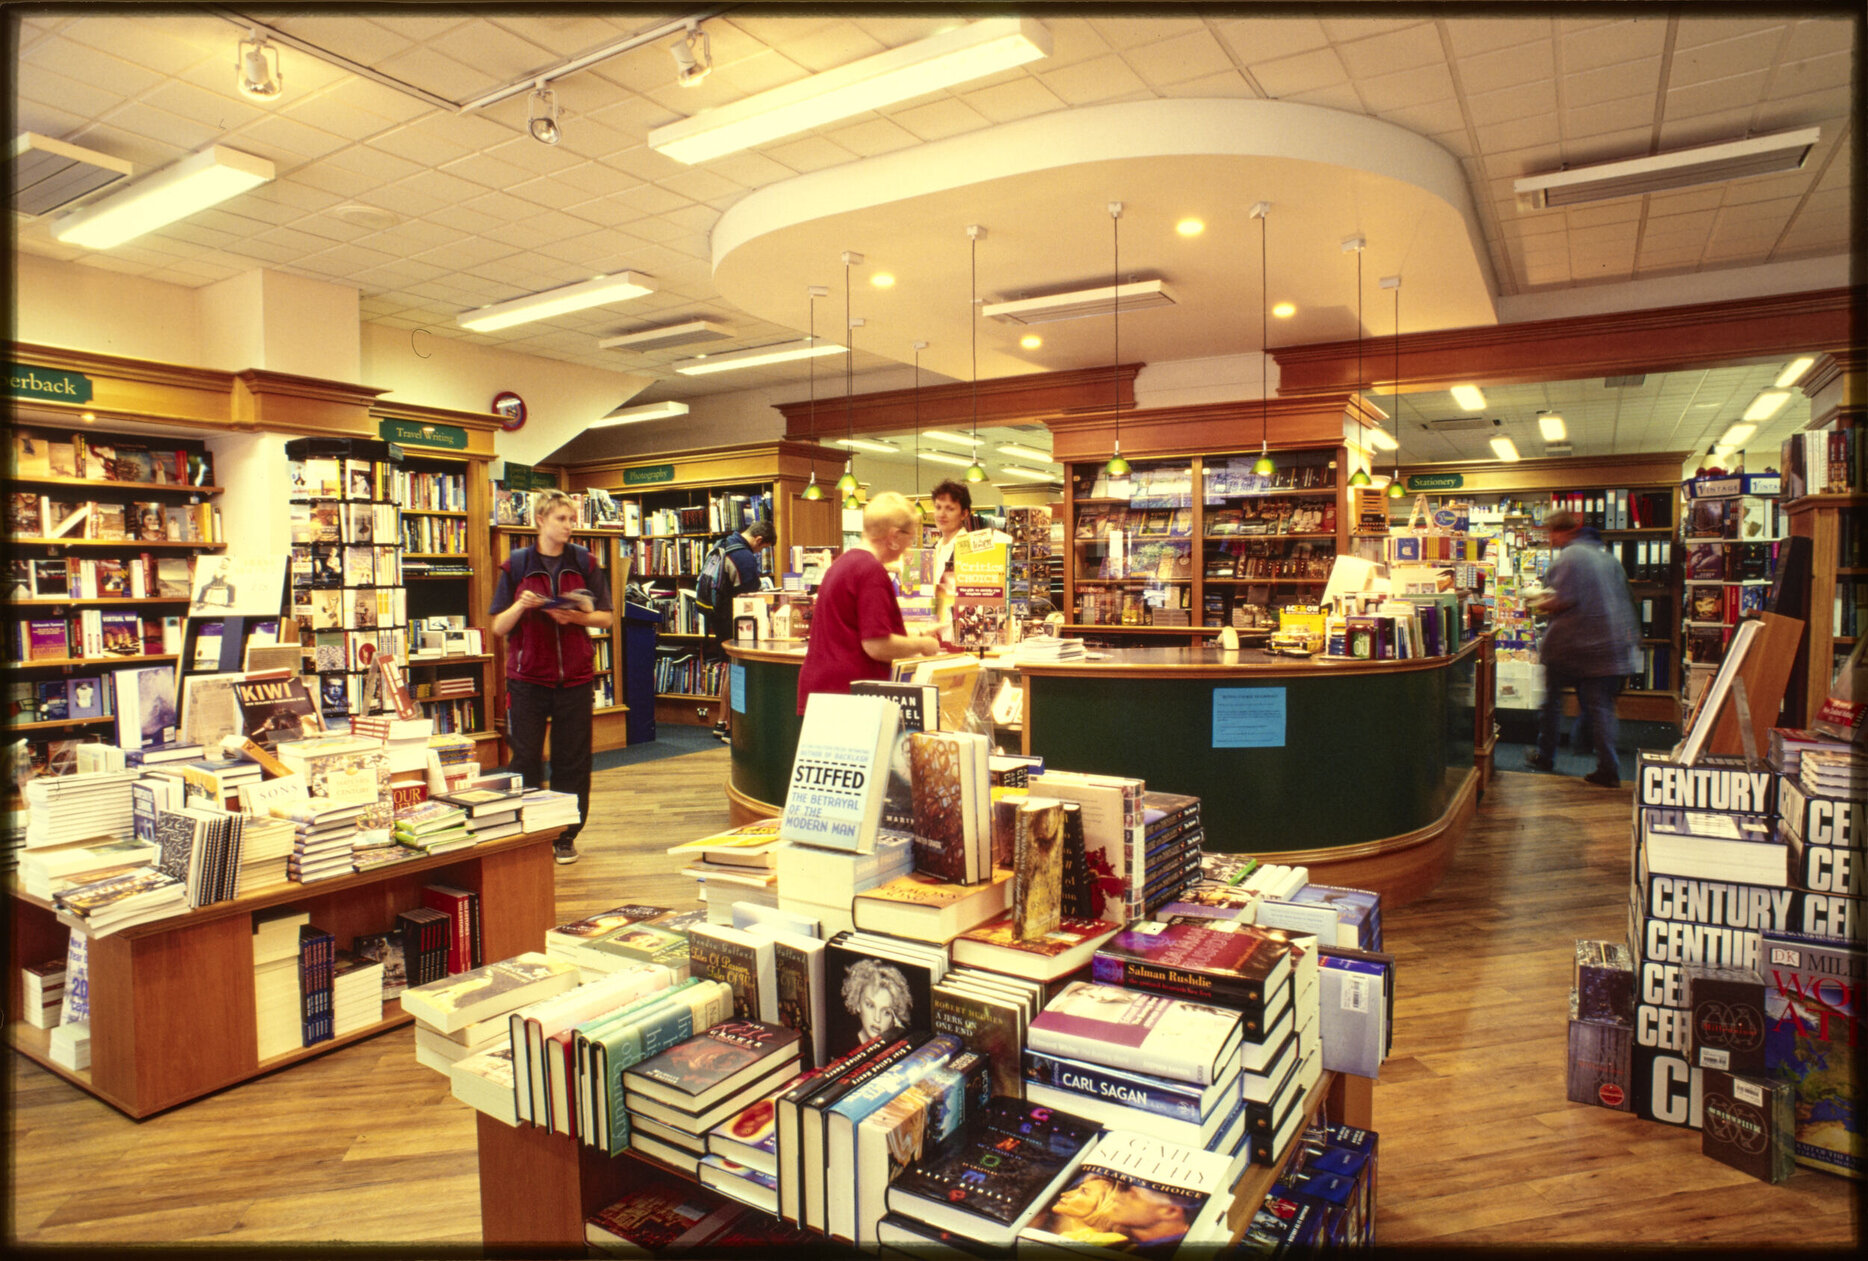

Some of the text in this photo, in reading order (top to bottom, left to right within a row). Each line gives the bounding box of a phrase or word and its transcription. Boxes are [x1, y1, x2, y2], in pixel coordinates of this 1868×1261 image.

[396, 427, 454, 444] Travel Writing
[1414, 477, 1457, 487] Stationery
[240, 682, 292, 701] KIWI
[795, 765, 865, 789] STIFFED
[1643, 766, 1770, 812] CENTURY
[792, 791, 859, 810] THE BETRAYAL
[789, 805, 822, 818] OF THE
[785, 817, 856, 836] MODERN MAN
[1652, 877, 1793, 931] CENTURY
[1774, 950, 1797, 963] DK
[1128, 964, 1212, 987] Salman Rushdie
[934, 1000, 1003, 1025] ROBERT HUGHES
[943, 1014, 962, 1026] JERK
[965, 1019, 977, 1030] ON
[936, 1021, 973, 1037] ONE END
[1062, 1073, 1098, 1094] CARL
[1101, 1081, 1147, 1105] SAGAN
[1082, 1164, 1203, 1199] HILLARY'S CHOICE
